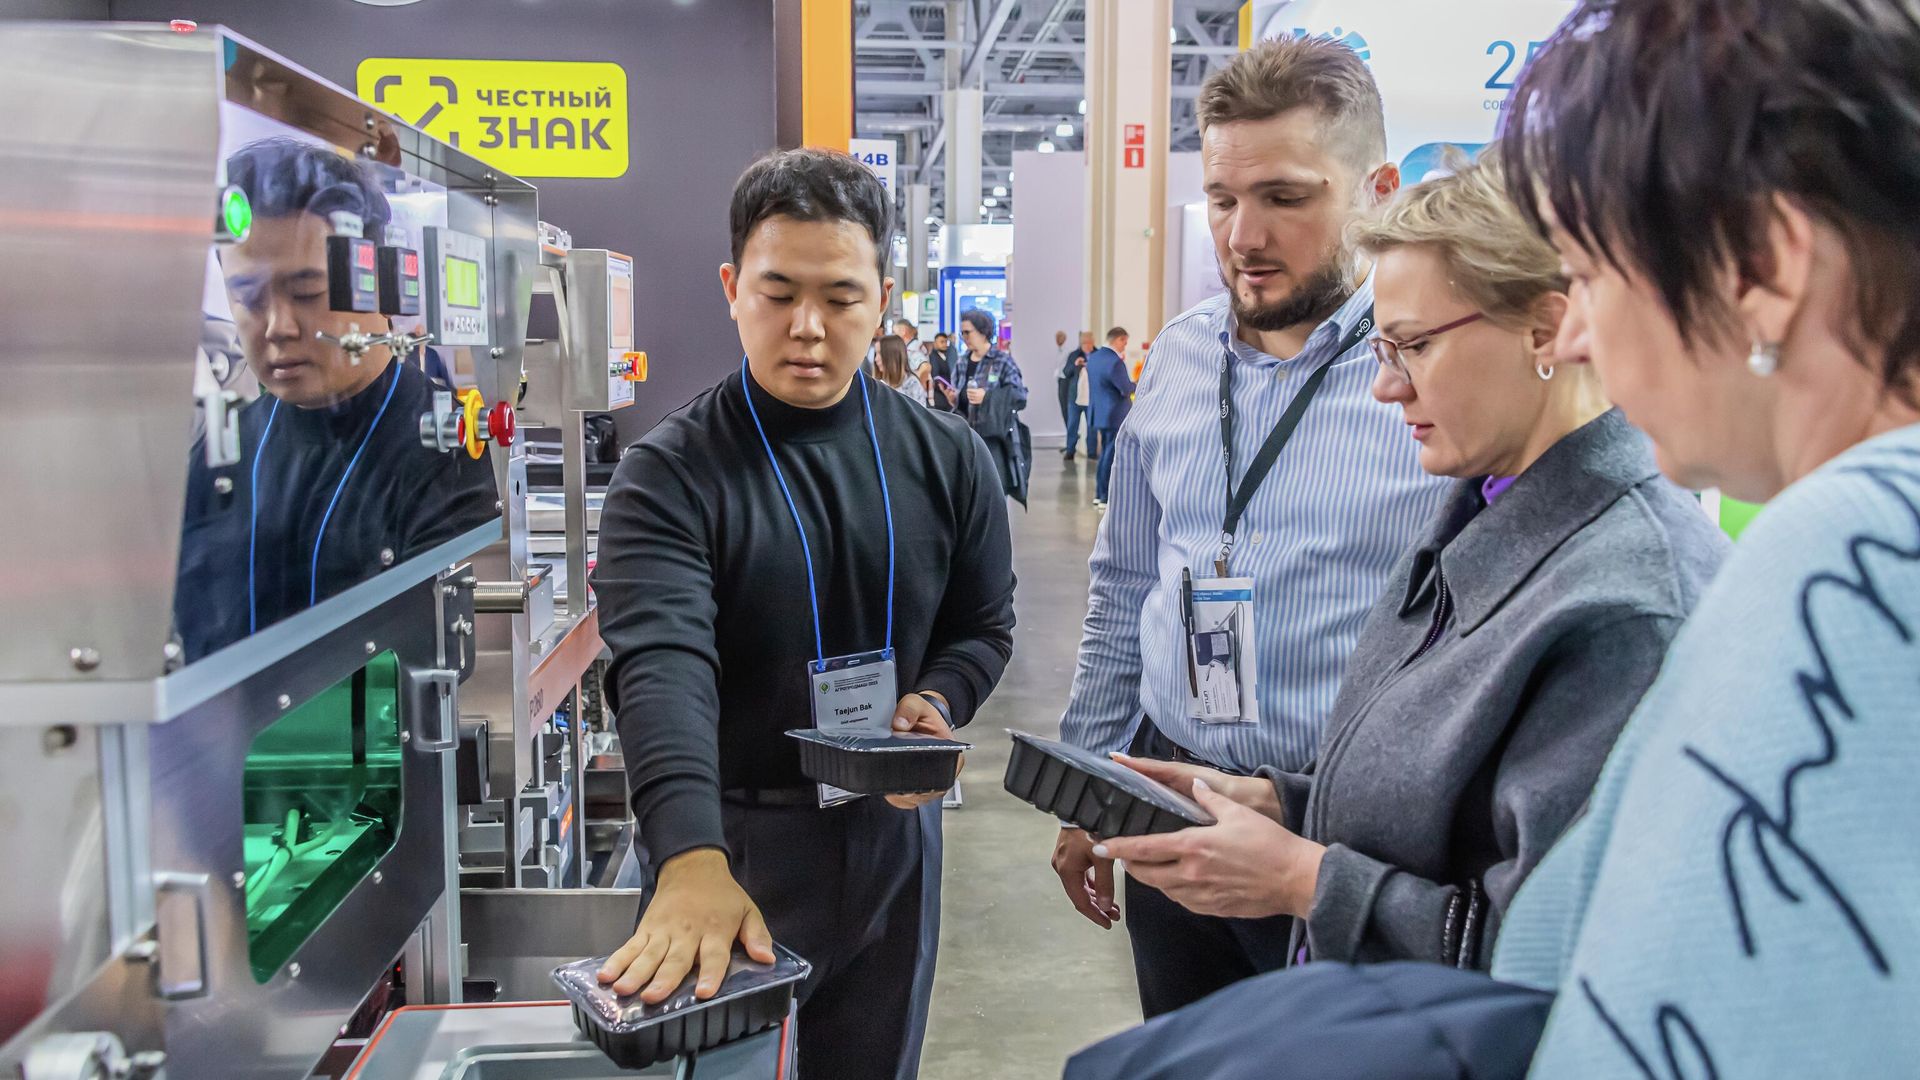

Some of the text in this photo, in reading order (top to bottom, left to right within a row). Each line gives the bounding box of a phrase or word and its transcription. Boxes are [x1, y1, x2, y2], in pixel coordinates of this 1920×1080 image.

[476, 86, 612, 109] ЧЕСТНЫЙ
[478, 117, 612, 151] ЗНАК
[834, 702, 873, 716] Taejun Bak
